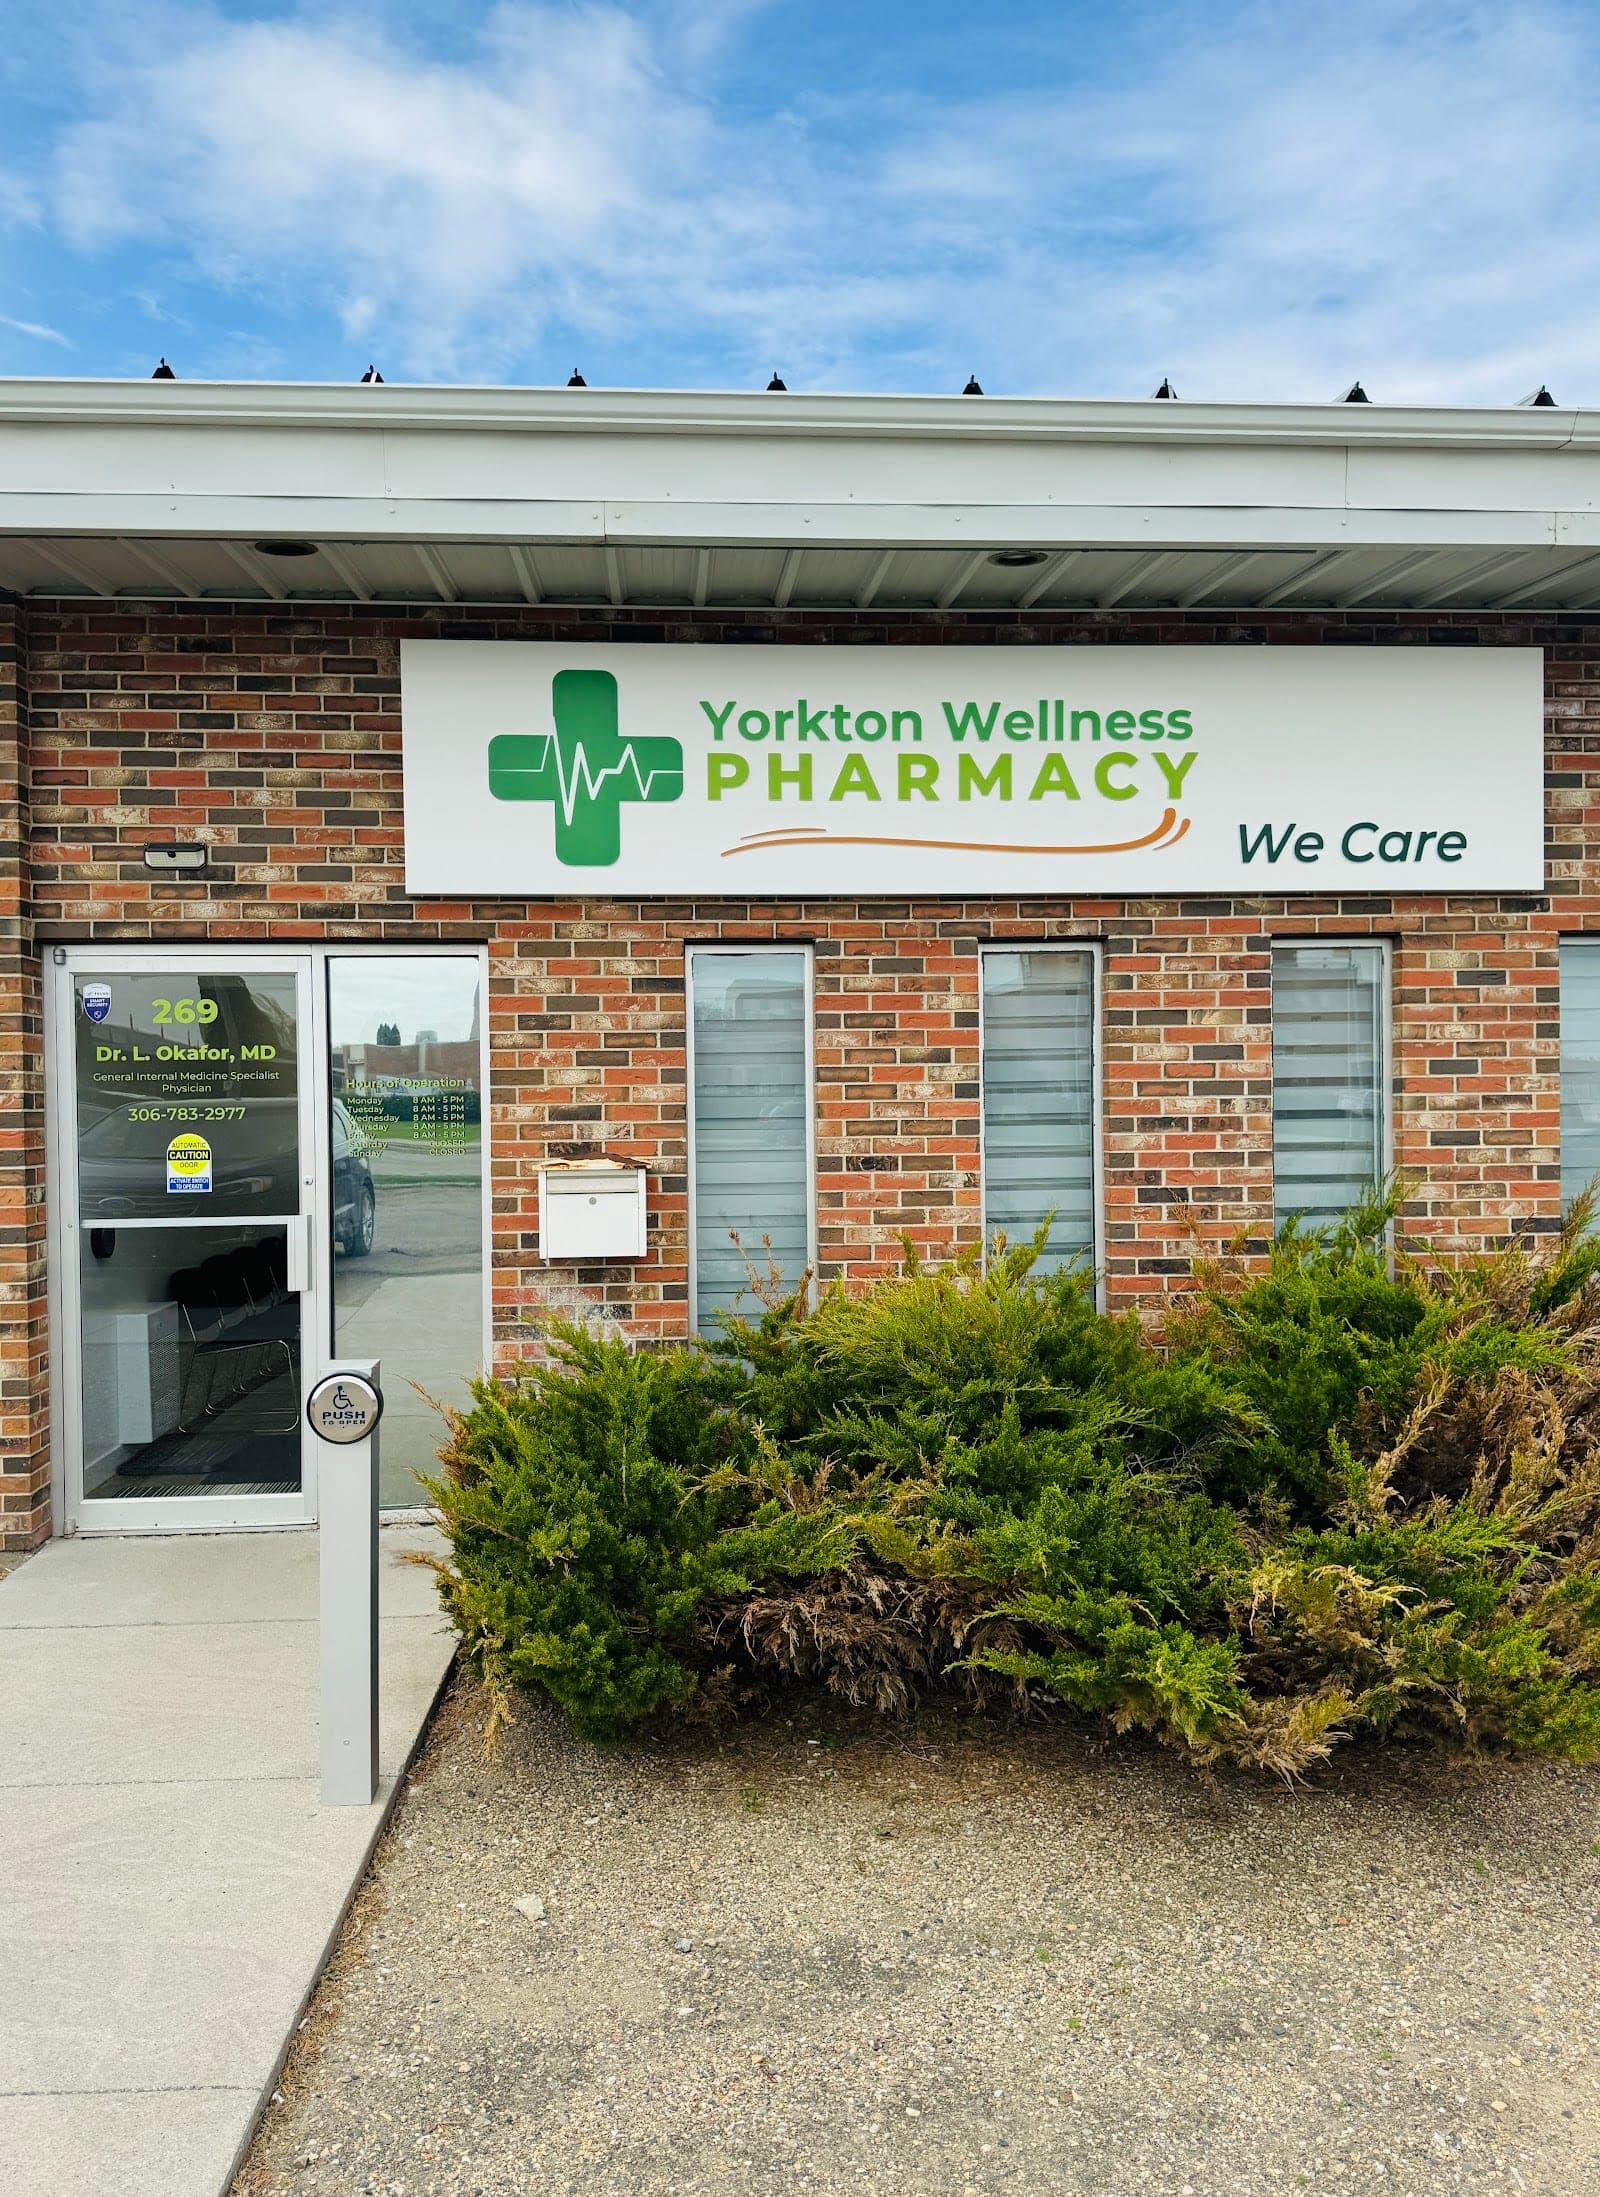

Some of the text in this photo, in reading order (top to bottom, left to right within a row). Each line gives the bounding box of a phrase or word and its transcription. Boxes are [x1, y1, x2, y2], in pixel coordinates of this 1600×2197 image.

[700, 700, 1194, 743] Yorkton Wellness
[707, 752, 1199, 802] PHARMACY
[1238, 822, 1468, 864] We Care
[152, 998, 219, 1025] 269
[96, 1045, 276, 1063] Dr. L. Okafor, MD
[93, 1071, 280, 1082] General Internal Medicine Specialist
[346, 1076, 465, 1089] Hours of Operation
[162, 1083, 212, 1094] Physician
[347, 1097, 383, 1105] Monday
[128, 1107, 246, 1122] 306-783-2977
[347, 1106, 384, 1114] Tuesday
[349, 1114, 400, 1122] Wednesday
[170, 1151, 209, 1160] CAUTION
[322, 1411, 366, 1420] PUSH
